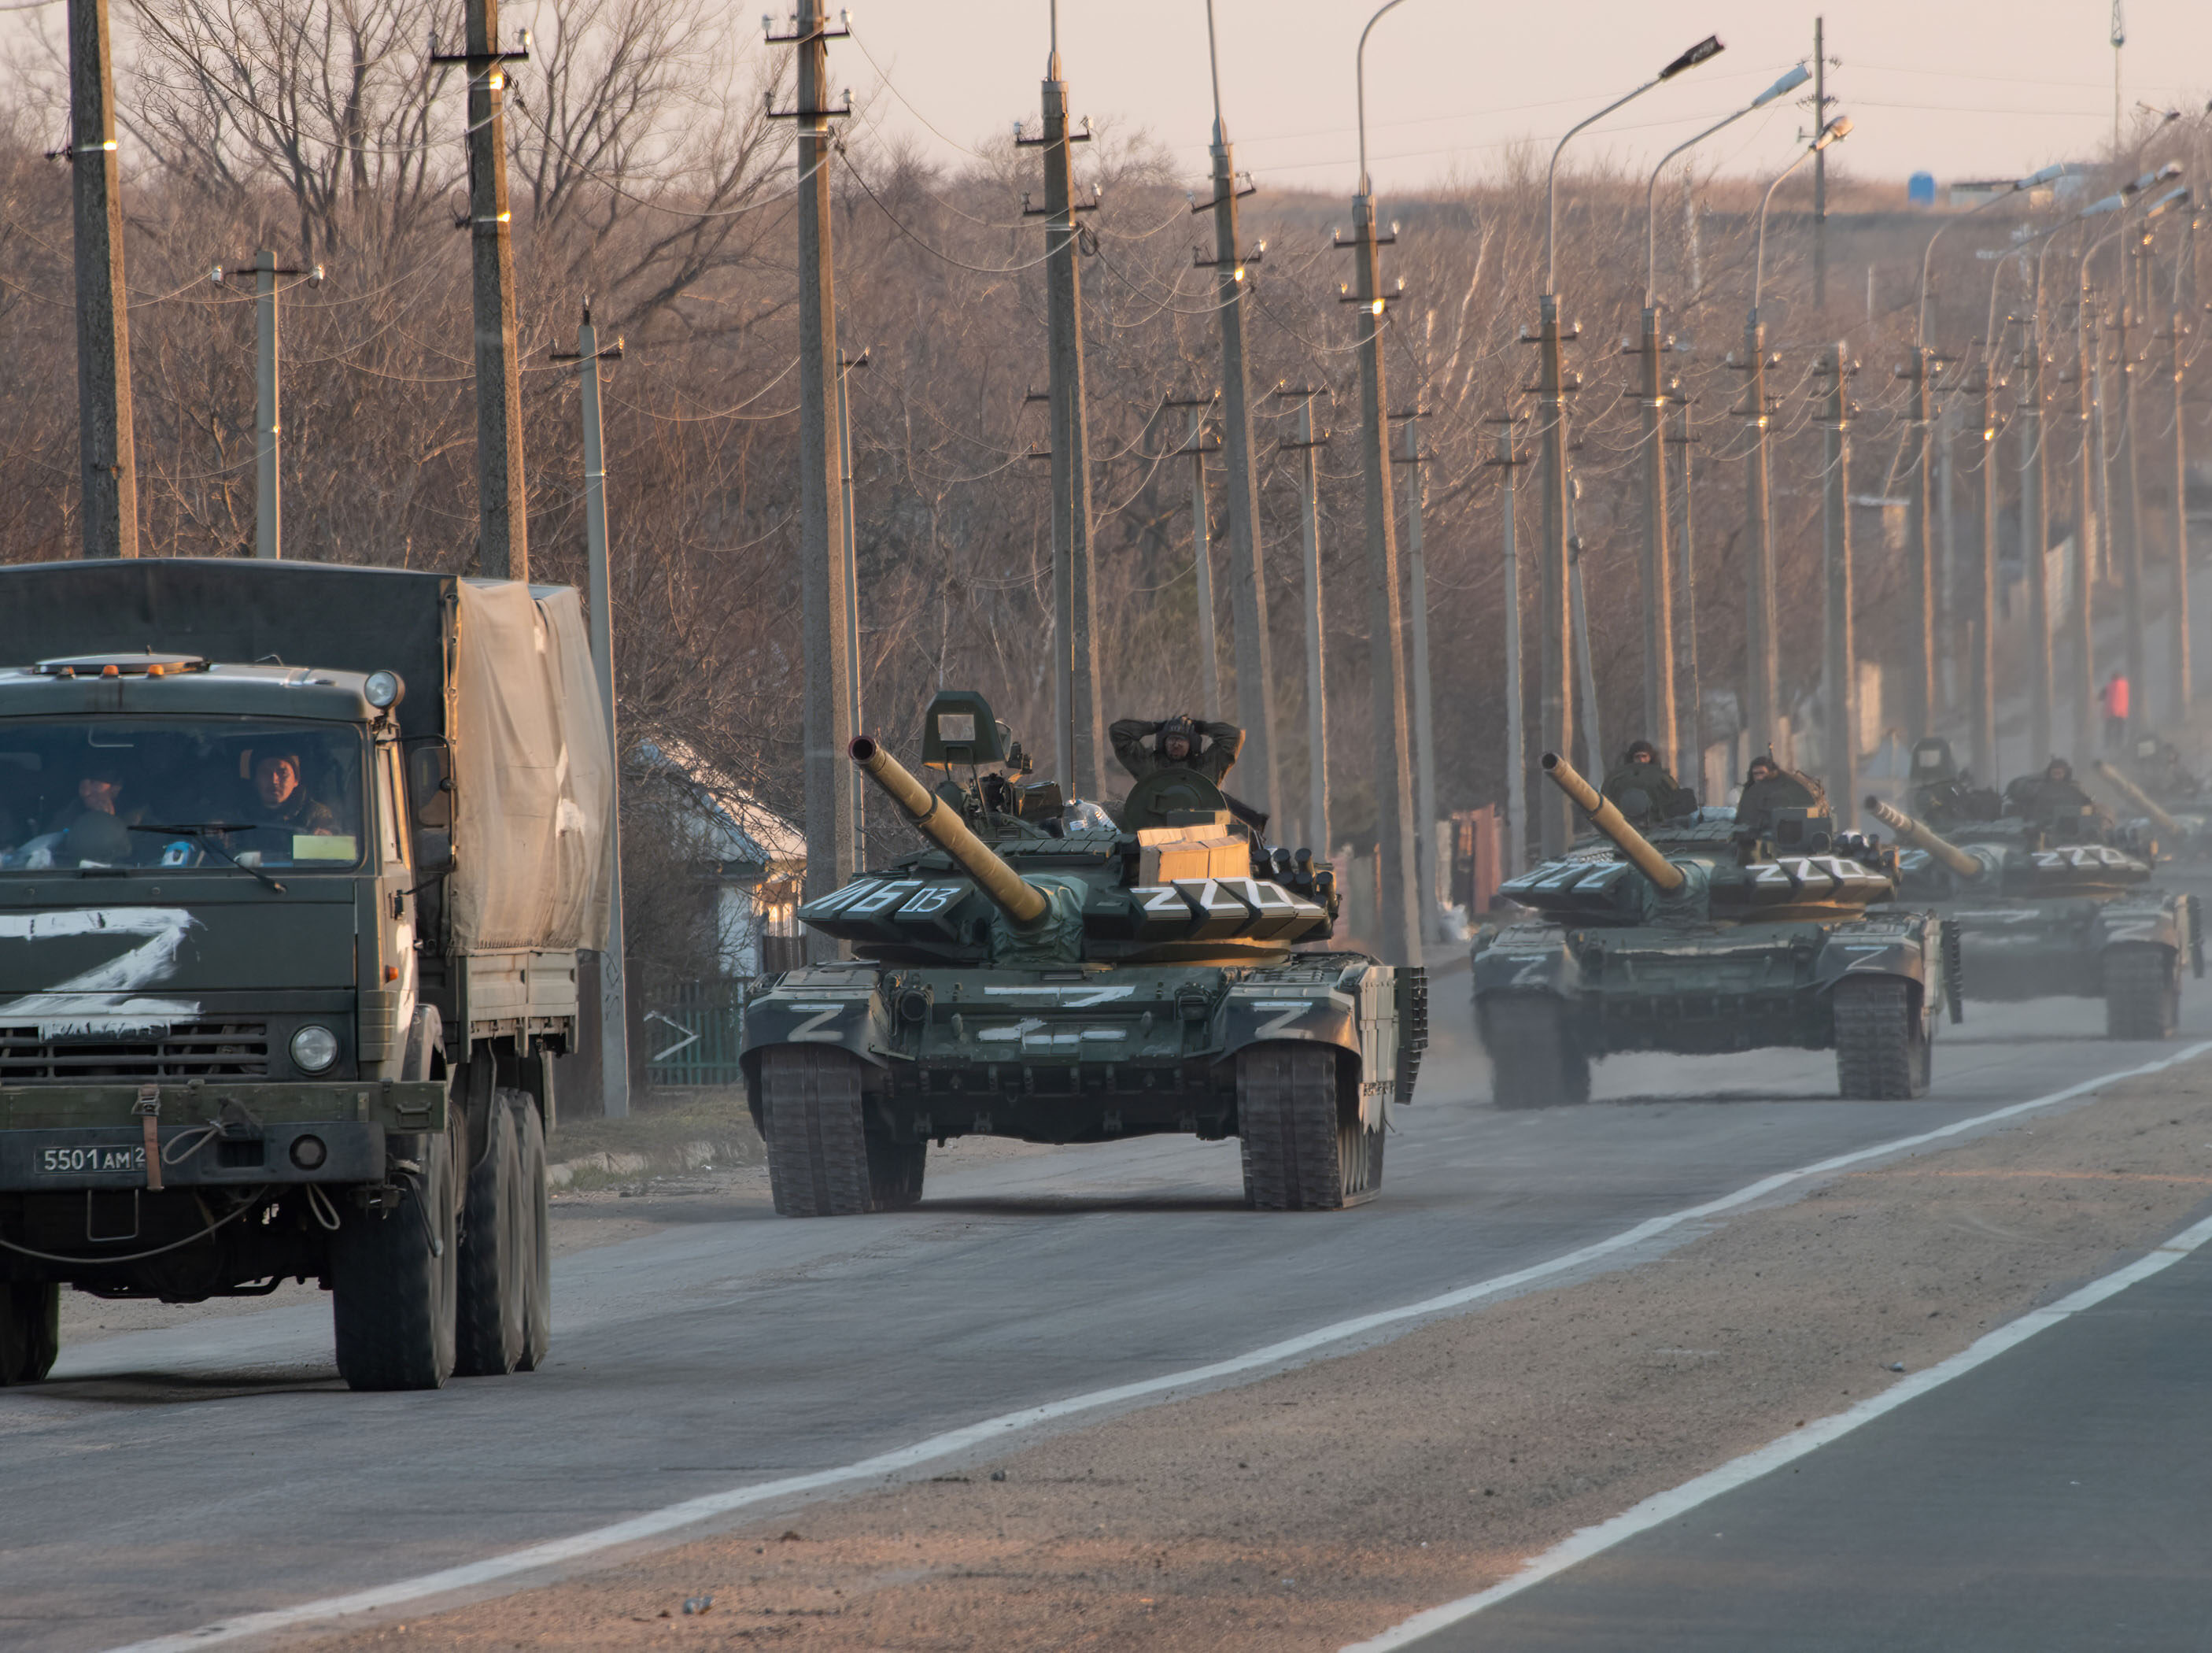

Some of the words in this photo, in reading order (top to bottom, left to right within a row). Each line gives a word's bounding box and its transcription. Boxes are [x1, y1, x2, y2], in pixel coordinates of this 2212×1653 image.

[0, 908, 201, 1042] Z
[1509, 955, 1549, 986] Z
[1845, 946, 1889, 971] Z
[788, 1004, 845, 1041] Z
[1250, 1001, 1313, 1040] Z
